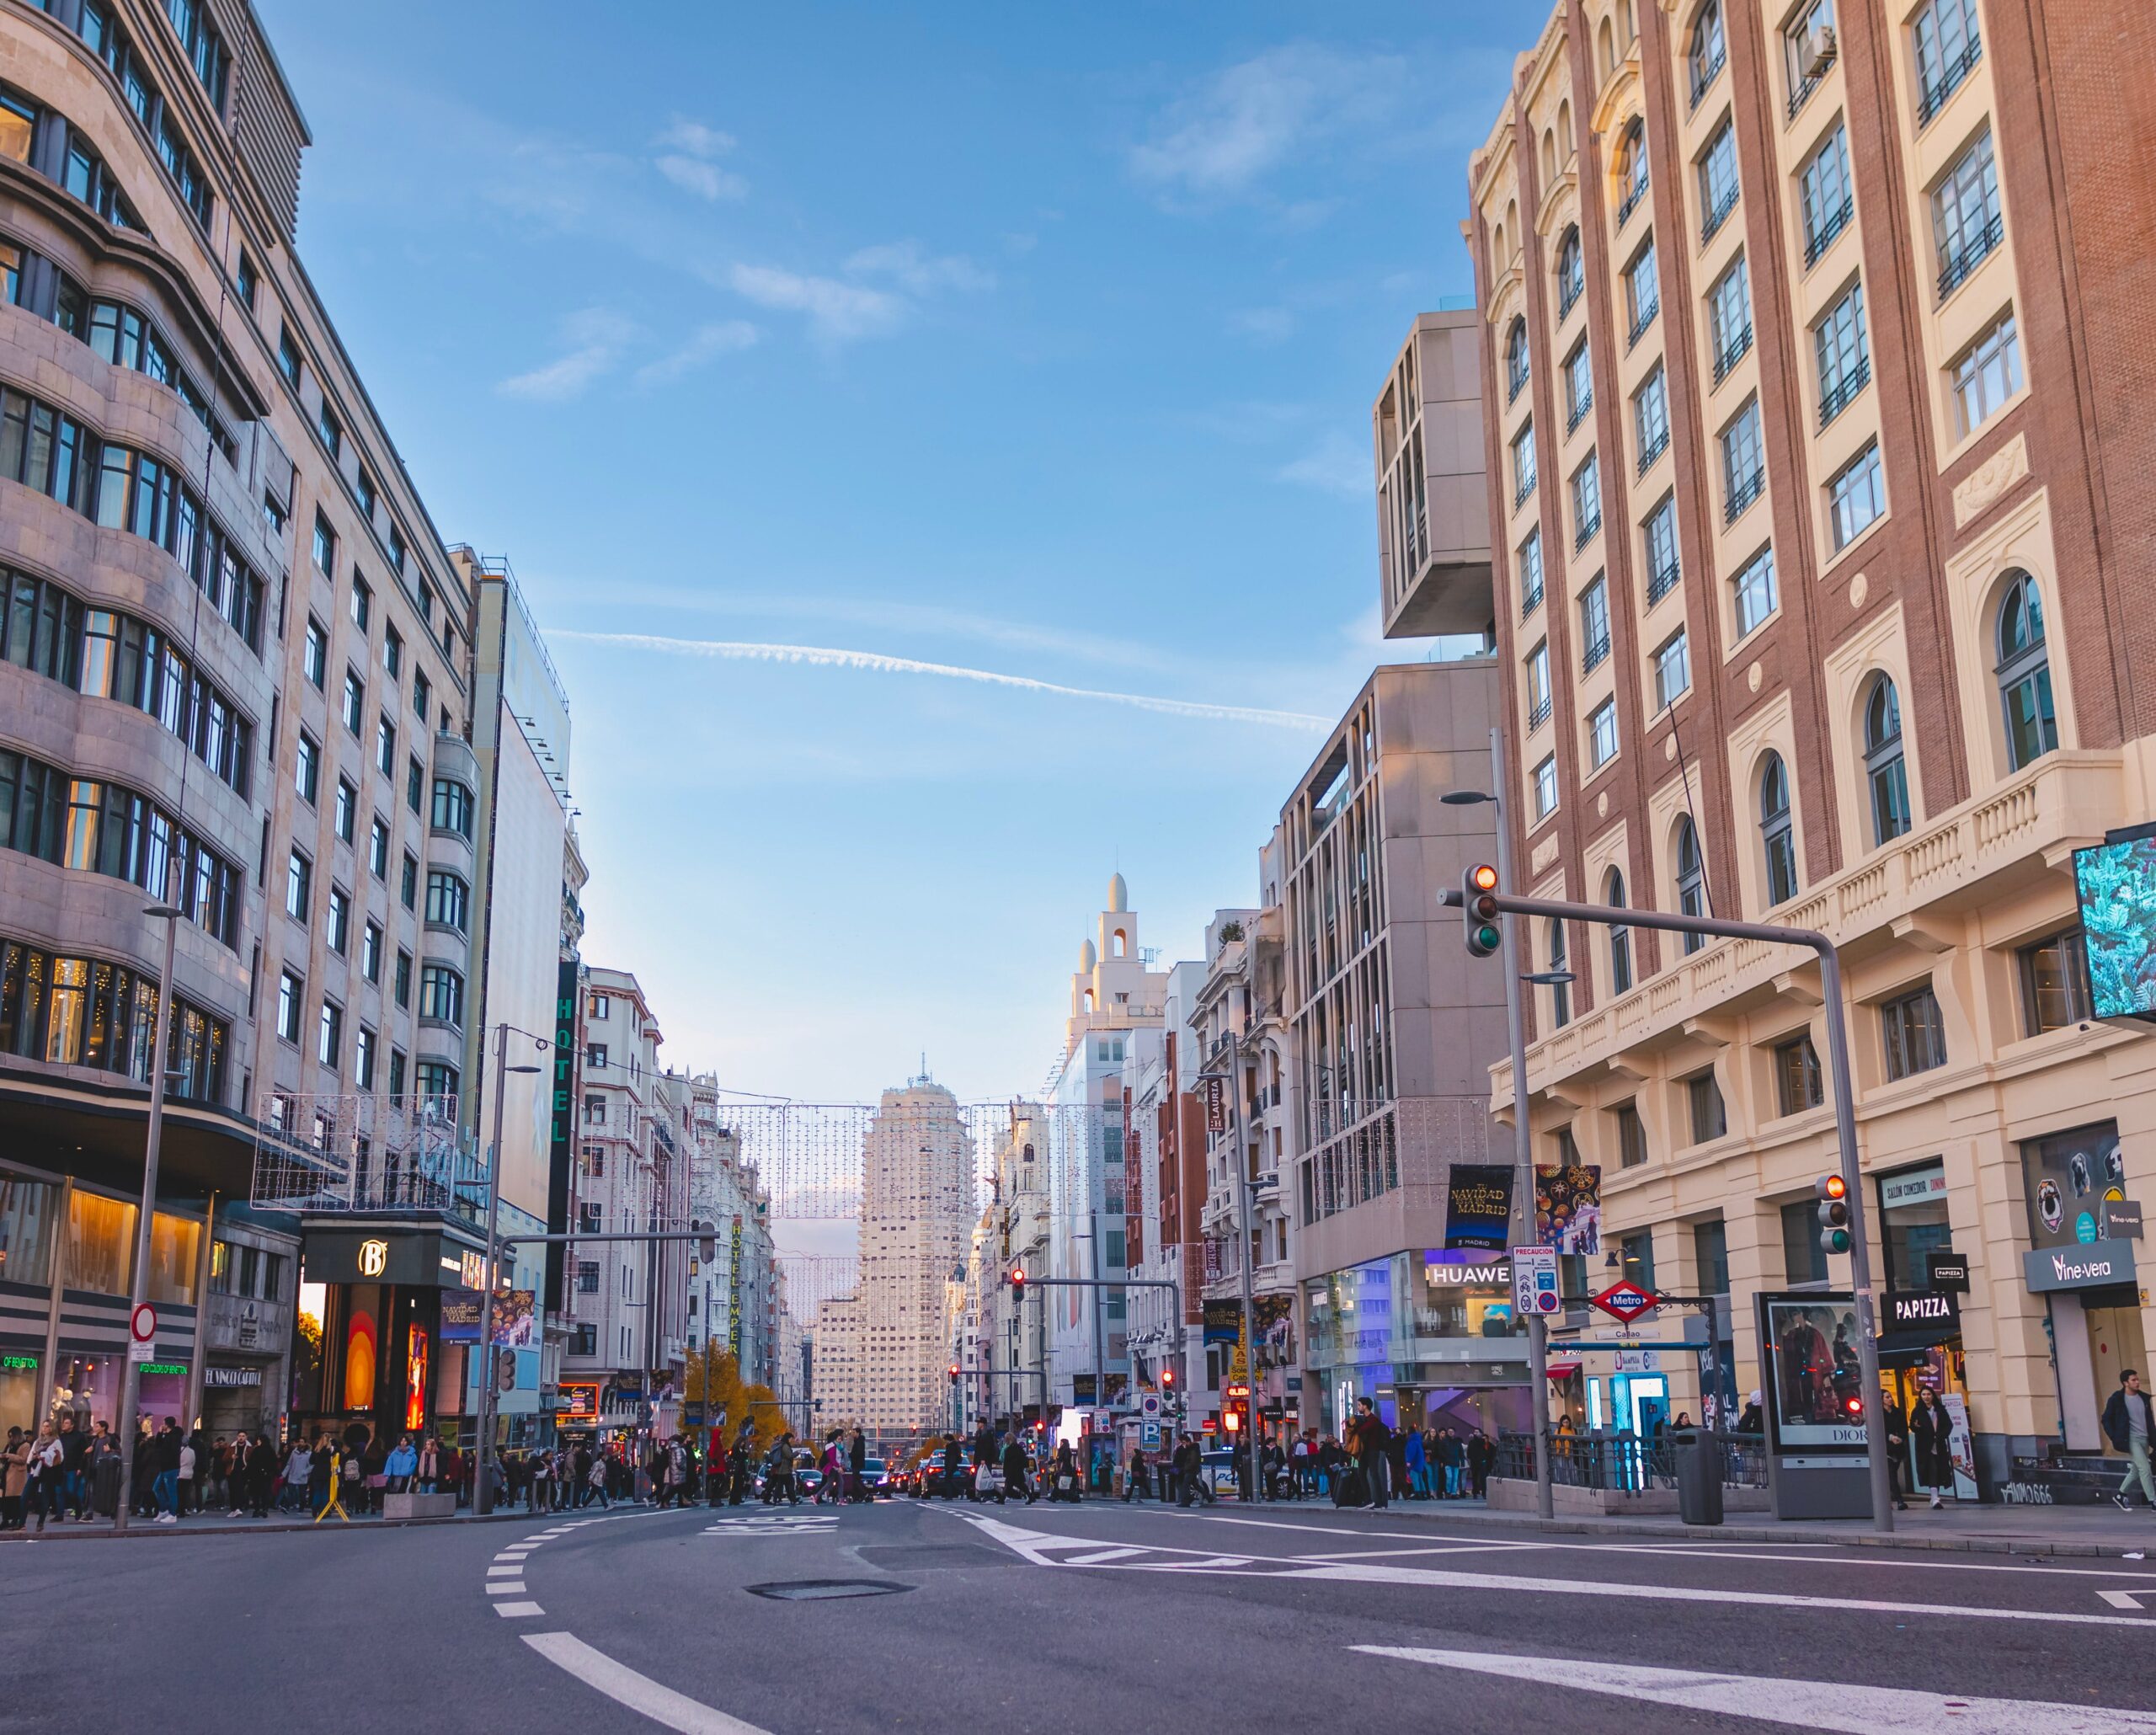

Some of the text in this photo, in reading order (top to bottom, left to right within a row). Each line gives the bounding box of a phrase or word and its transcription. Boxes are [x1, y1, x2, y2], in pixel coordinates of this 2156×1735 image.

[552, 999, 572, 1141] HOTEL
[1211, 1081, 1219, 1118] LAURIA
[1451, 1188, 1504, 1199] NAVIDAD
[1886, 1183, 1903, 1199] SALÓN
[1903, 1180, 1927, 1196] COMEDOR
[1458, 1204, 1508, 1215] MADRID
[1207, 1239, 1217, 1270] EXCELSIOR
[1433, 1267, 1510, 1283] HUAWE
[728, 1225, 741, 1355] HOTEL EMPER
[1613, 1296, 1641, 1305] Metro
[1896, 1297, 1951, 1320] PAPIZZA
[3, 1356, 12, 1367] OF
[1144, 1423, 1159, 1441] P
[1833, 1429, 1868, 1441] DIOR
